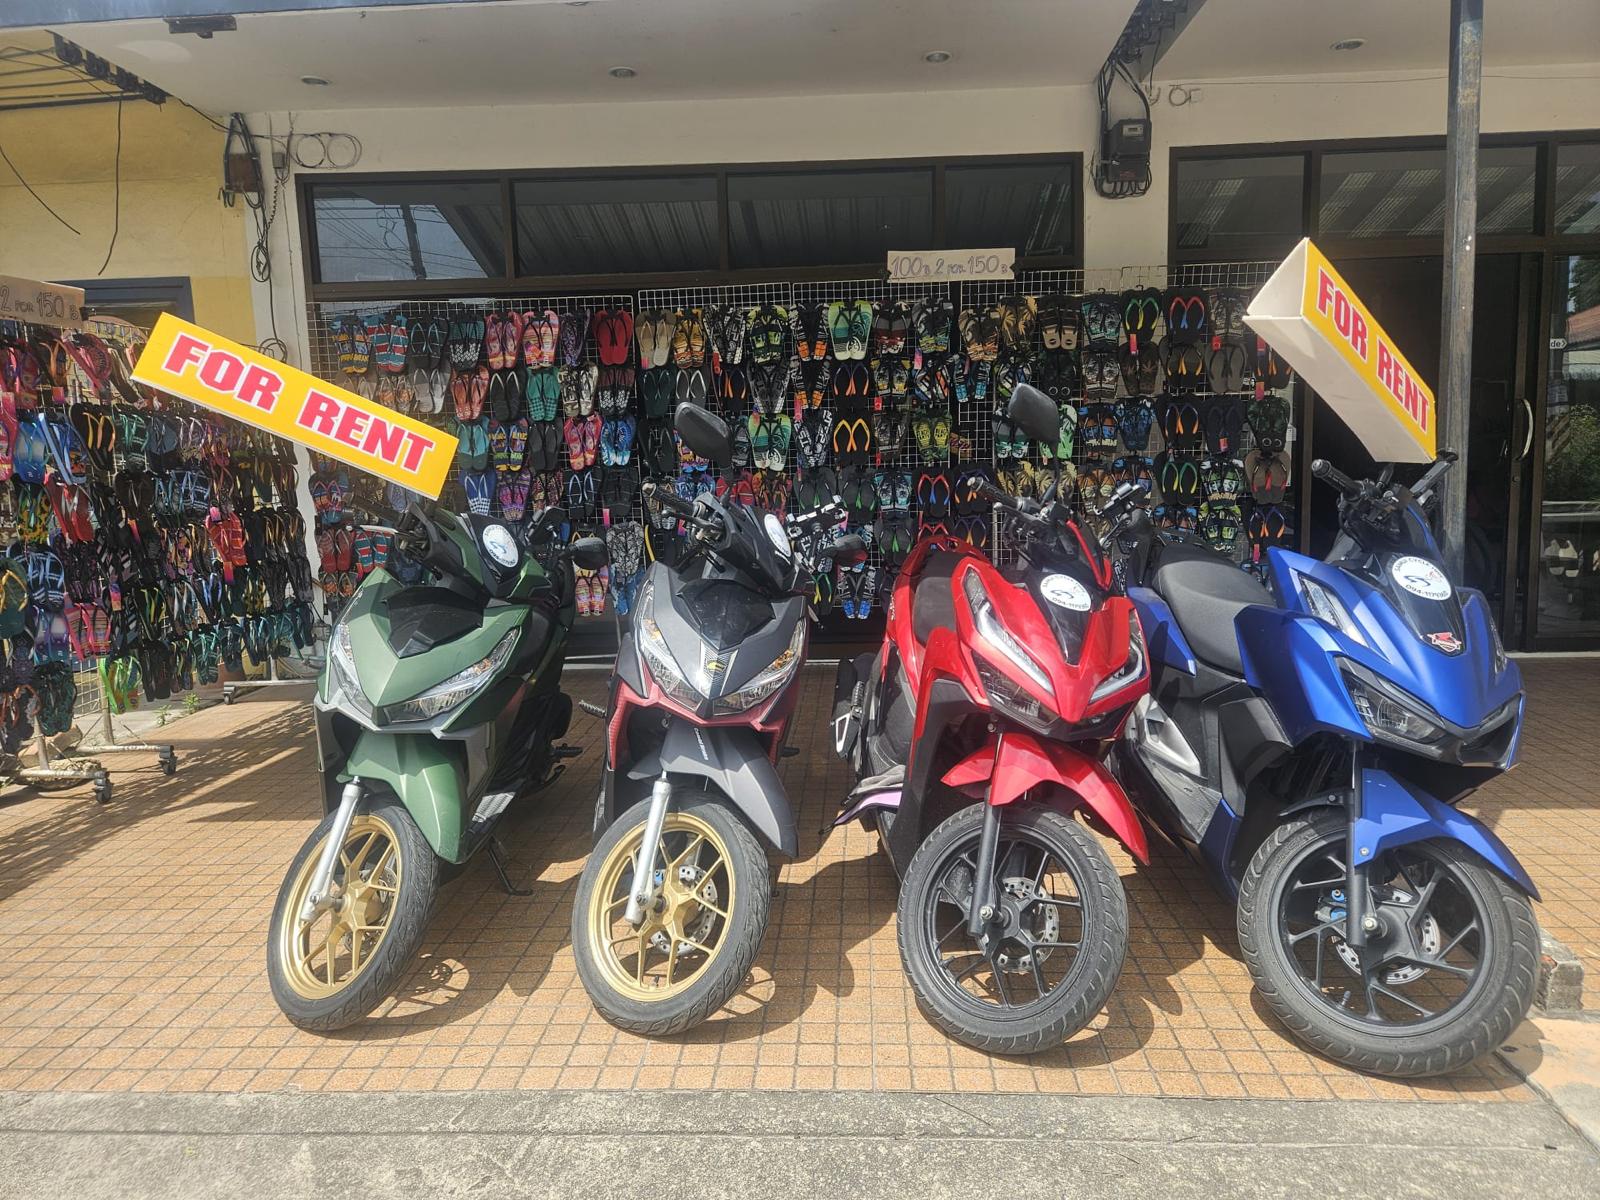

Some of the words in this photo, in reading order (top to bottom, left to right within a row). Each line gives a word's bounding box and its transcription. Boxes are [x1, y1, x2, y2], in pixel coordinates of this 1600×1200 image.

[0, 285, 12, 312] 2
[15, 301, 34, 313] FOR
[36, 291, 65, 318] 150
[934, 258, 945, 274] 2
[1316, 265, 1368, 363] FOR
[1376, 336, 1429, 434] RENT
[161, 331, 283, 413] FOR
[297, 387, 435, 475] RENT
